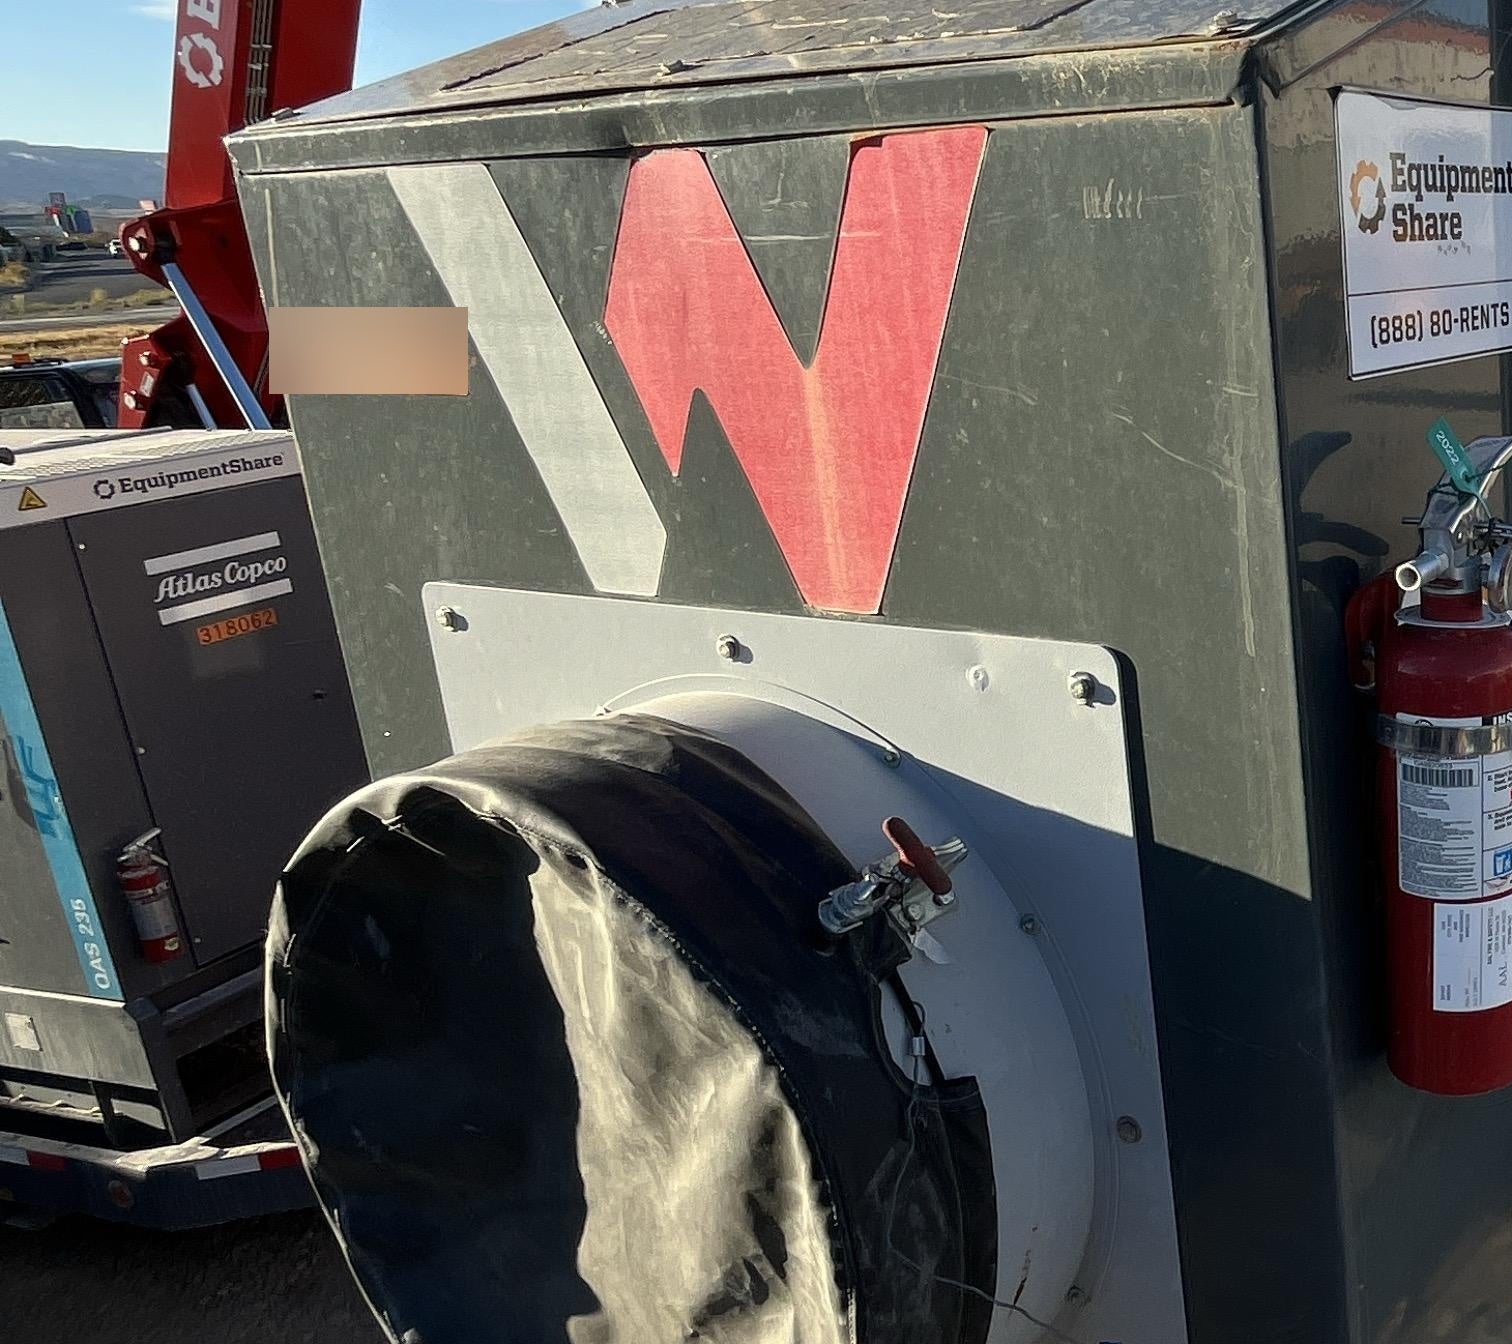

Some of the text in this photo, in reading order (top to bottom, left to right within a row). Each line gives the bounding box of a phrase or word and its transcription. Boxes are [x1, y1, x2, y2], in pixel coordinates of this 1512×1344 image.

[1391, 203, 1463, 243] Share
[1370, 301, 1510, 349] (888) 80-RENTS
[1435, 430, 1460, 465] 2022
[118, 454, 284, 494] EquipmentShare
[152, 556, 287, 604] Atlas Copco
[199, 609, 274, 644] 318062
